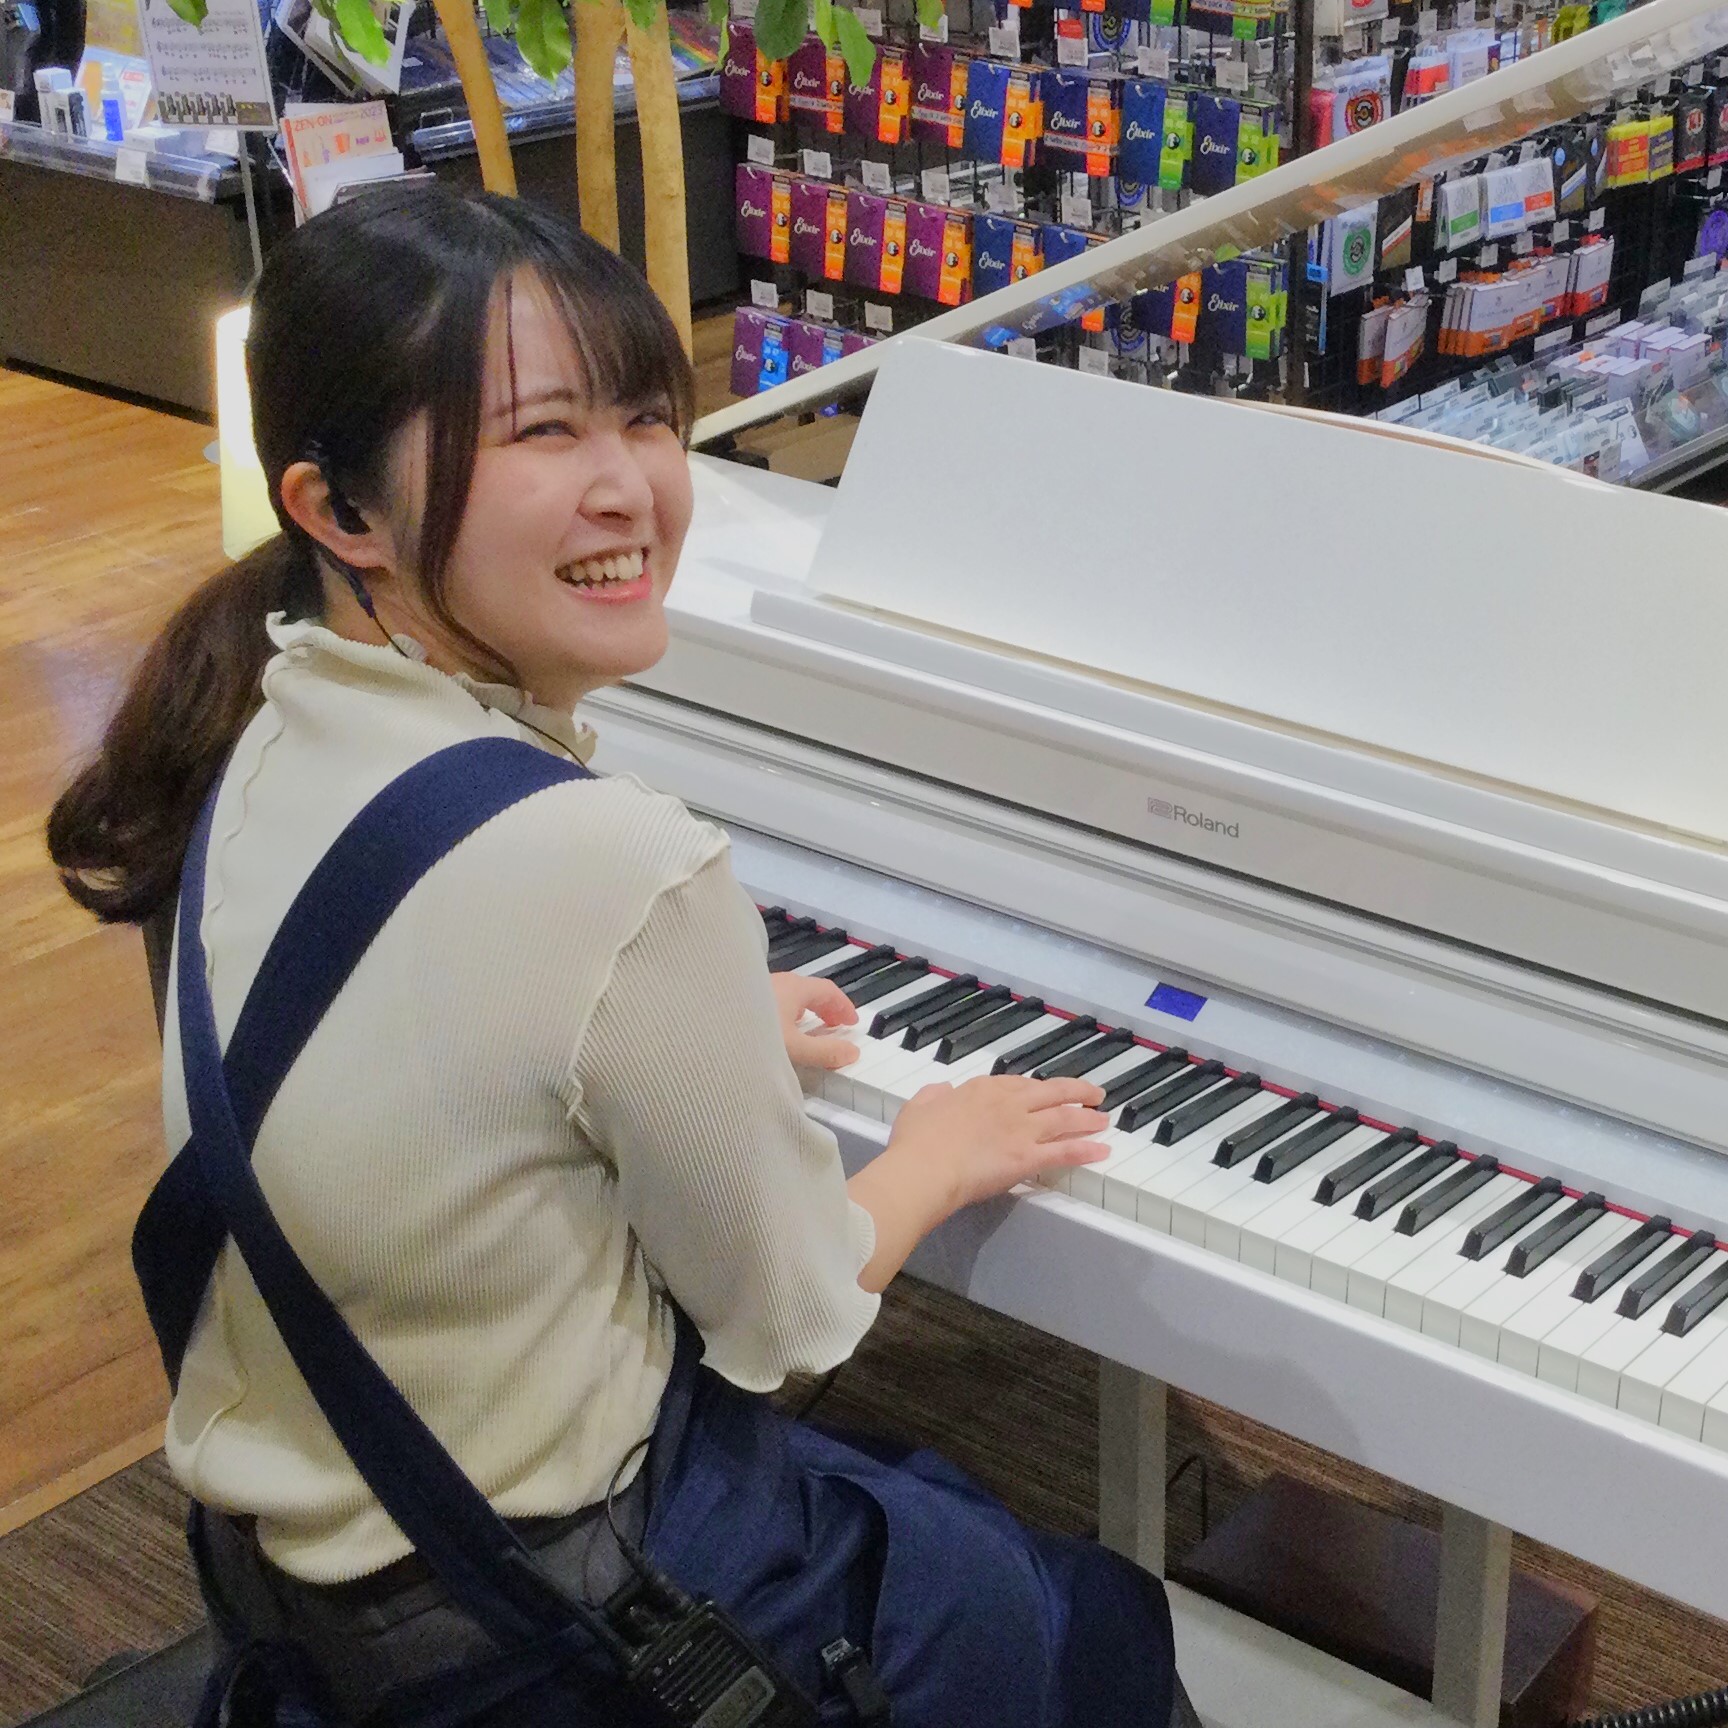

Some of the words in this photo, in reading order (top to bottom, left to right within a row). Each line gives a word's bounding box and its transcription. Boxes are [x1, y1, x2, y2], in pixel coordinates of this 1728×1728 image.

[724, 59, 751, 77] Elixir
[794, 72, 820, 89] Elixir
[917, 83, 945, 102] Elixir
[970, 100, 998, 119] Elixir
[1050, 111, 1080, 131] Elixir
[1126, 121, 1156, 141] Elixir
[1200, 135, 1231, 155] Elixir
[740, 200, 767, 218] Elixir
[794, 217, 820, 235] Elixir
[850, 228, 877, 247] Elixir
[909, 239, 936, 257] Elixir
[978, 252, 1006, 270] Elixir
[1207, 293, 1239, 313] Elixir
[735, 345, 757, 362] Elixir
[1173, 805, 1240, 839] Roland
